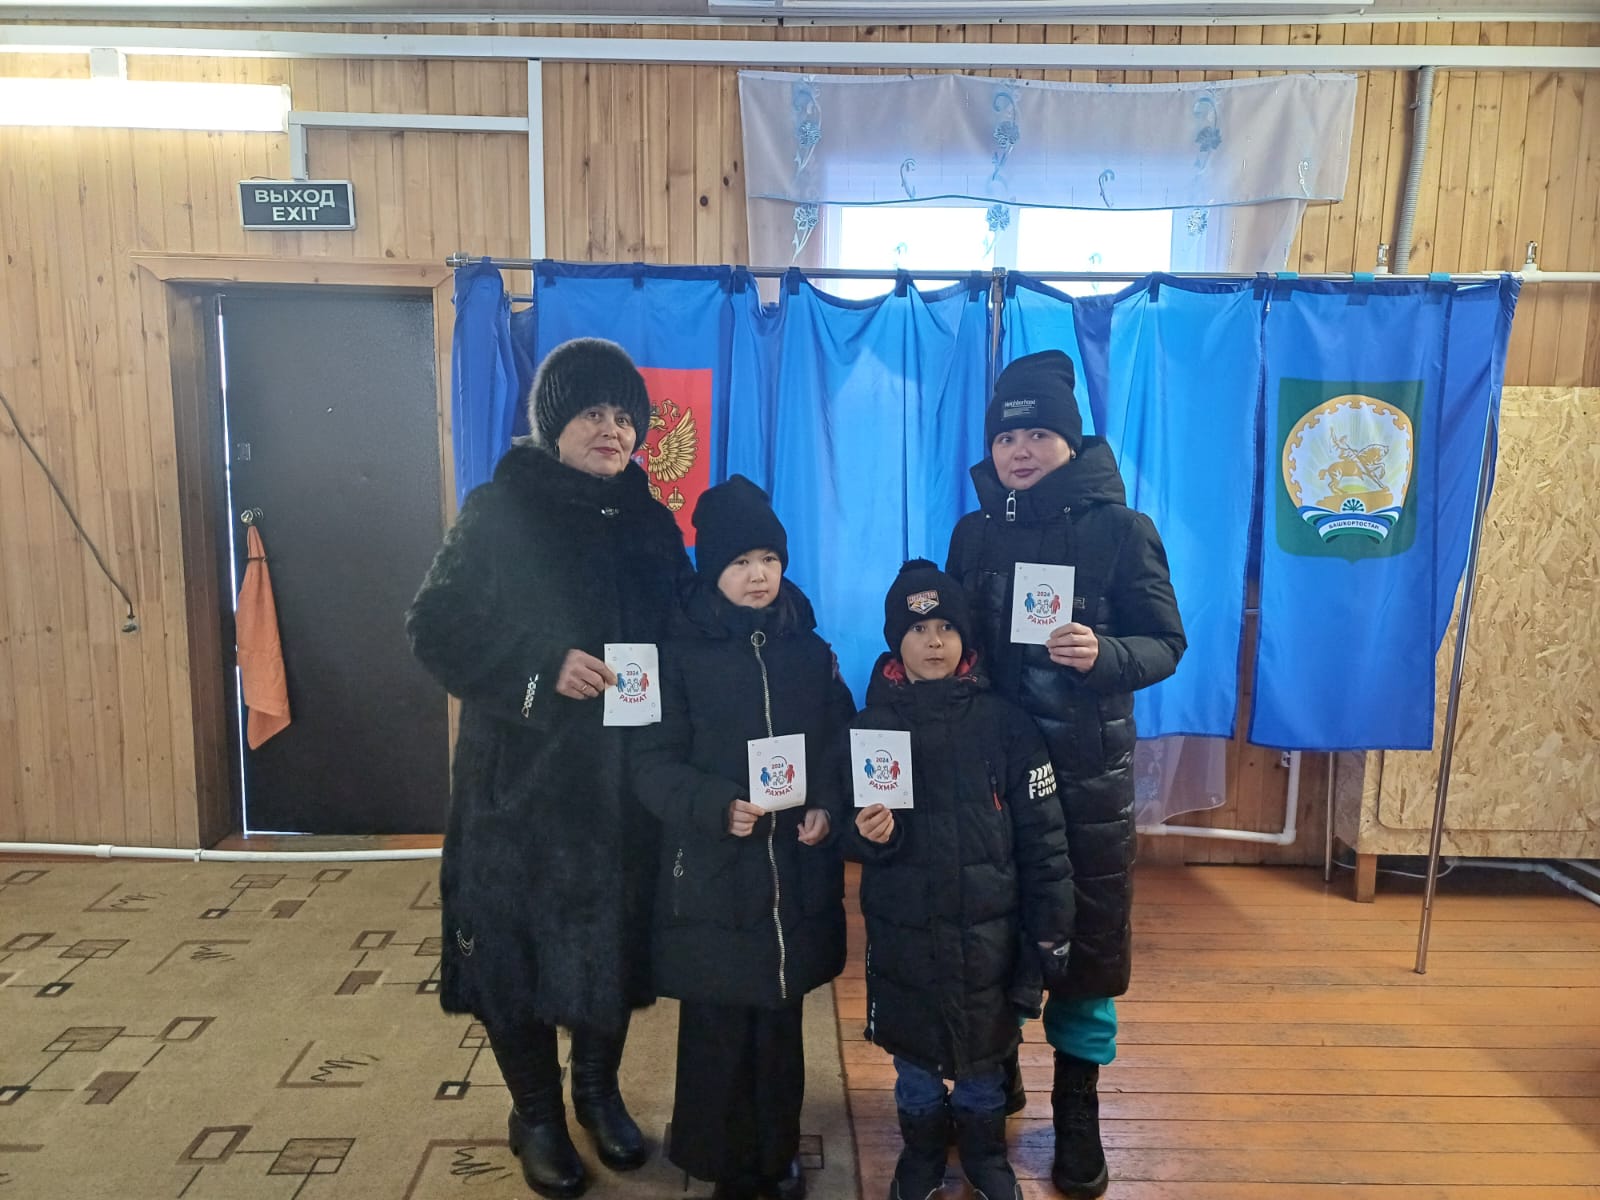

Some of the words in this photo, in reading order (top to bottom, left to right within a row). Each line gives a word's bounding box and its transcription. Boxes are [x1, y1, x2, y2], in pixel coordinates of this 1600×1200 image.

[254, 189, 335, 207] ВЫХОД
[272, 206, 320, 221] EXIT
[1027, 614, 1057, 625] РАХМАТ
[619, 694, 648, 704] РАХМАТ
[765, 785, 793, 797] РАХМАТ
[869, 780, 899, 791] РАХМАТ
